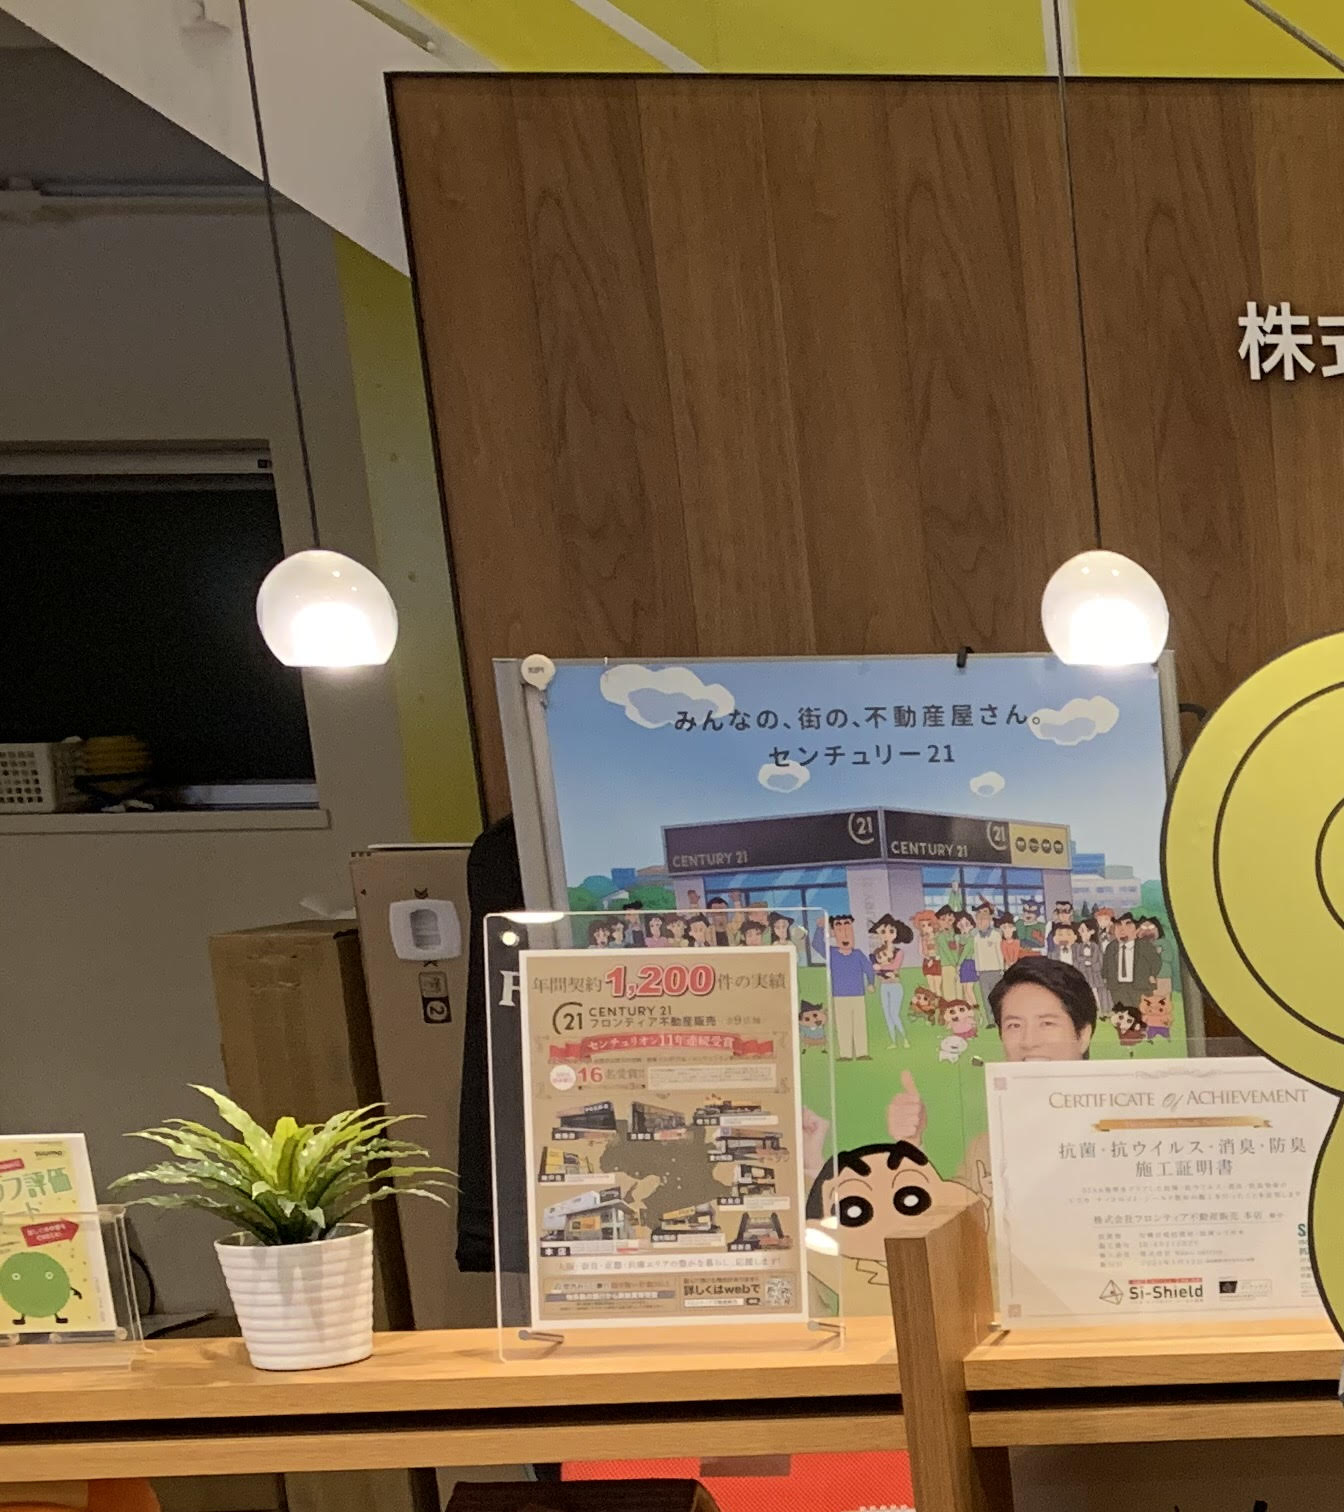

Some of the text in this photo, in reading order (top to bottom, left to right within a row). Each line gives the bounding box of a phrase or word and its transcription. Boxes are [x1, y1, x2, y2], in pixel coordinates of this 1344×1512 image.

[673, 703, 1041, 732] みんなの、街の、不動産屋さん。
[768, 744, 956, 768] センチュリー21
[890, 840, 968, 858] CENTURY 21
[672, 850, 749, 868] CENTURY 21
[588, 1005, 673, 1018] CENTURY 21
[590, 1016, 717, 1029] フロンティア不動産販売
[1049, 1092, 1155, 1109] CERTIFICATE
[1186, 1088, 1310, 1106] ACHIEVEMENT
[1058, 1136, 1307, 1160] 抗菌・抗ウイルス・消臭・防臭
[1135, 1158, 1234, 1178] 施工証明書
[684, 1284, 761, 1296] 詳しくはwebで
[1129, 1284, 1204, 1300] Si-Shield
